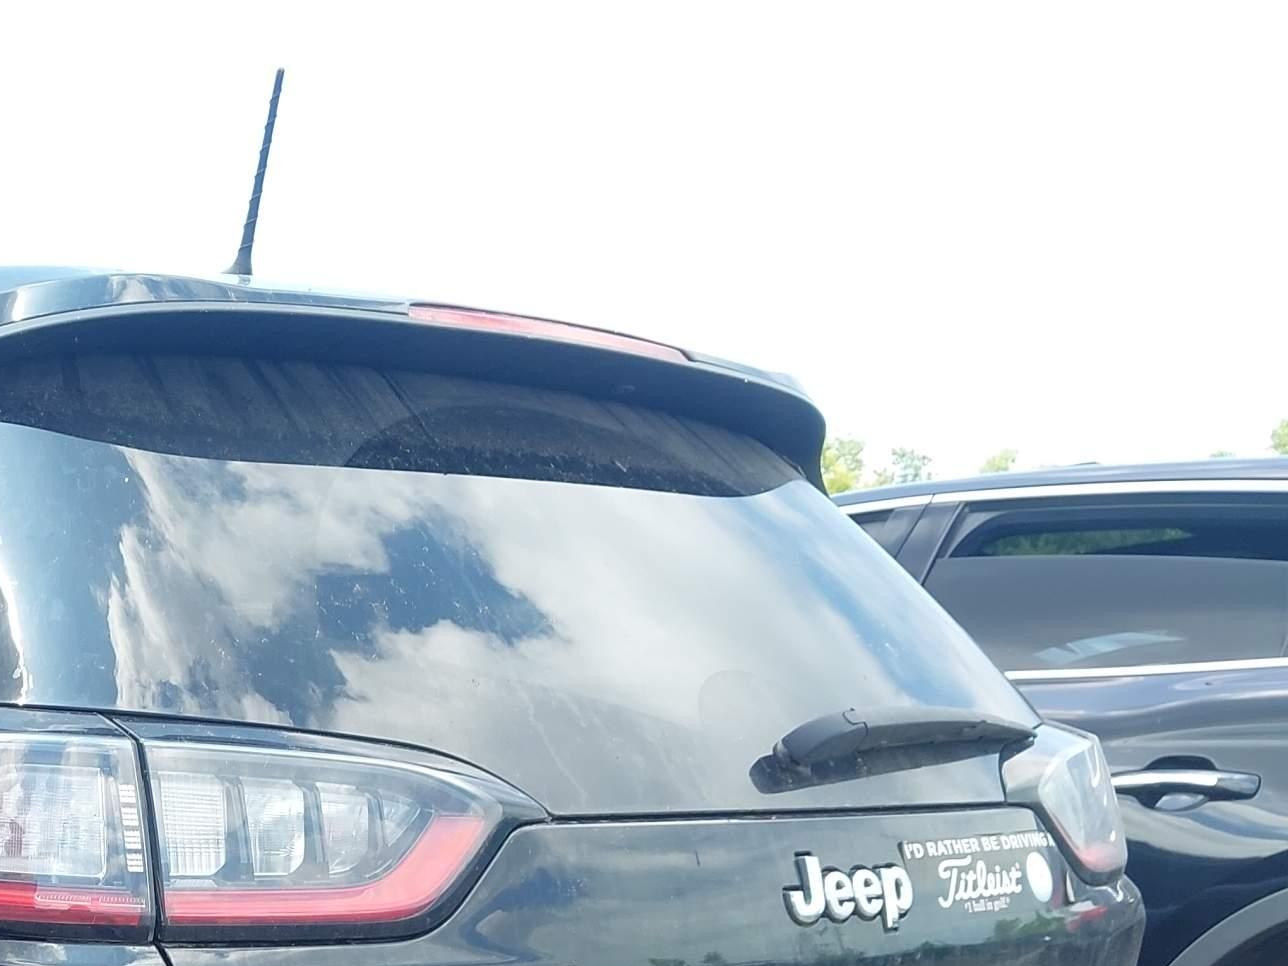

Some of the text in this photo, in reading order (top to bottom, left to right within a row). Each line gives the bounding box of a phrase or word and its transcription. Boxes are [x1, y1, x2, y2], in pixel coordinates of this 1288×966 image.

[904, 841, 925, 860] I'D
[926, 838, 981, 857] RATHER
[981, 834, 1002, 852] BE
[1001, 831, 1048, 850] DRIVING
[783, 852, 914, 931] Jeep
[937, 855, 1023, 909] Titleist
